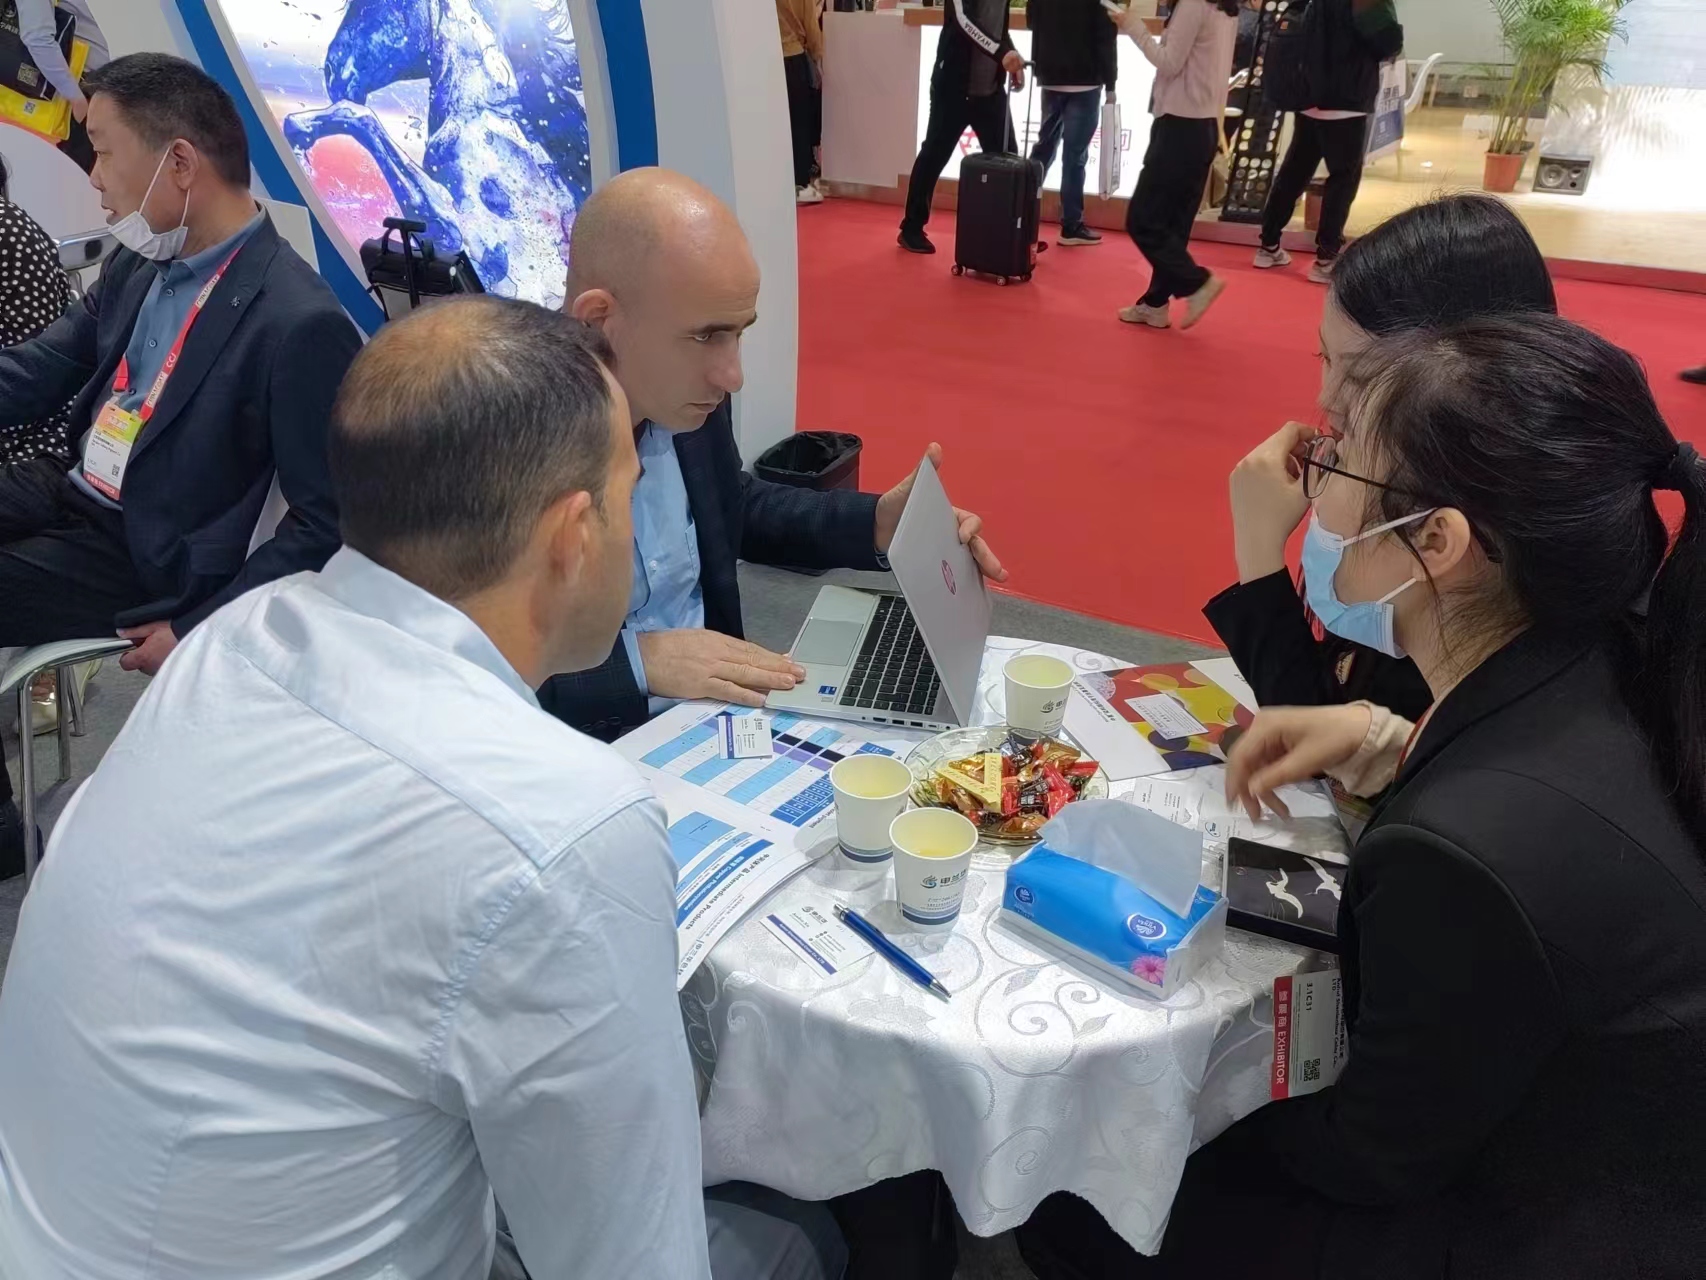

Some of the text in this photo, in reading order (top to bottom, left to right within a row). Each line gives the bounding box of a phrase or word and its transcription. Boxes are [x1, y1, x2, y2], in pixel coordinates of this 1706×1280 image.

[709, 871, 743, 905] Intermediate
[684, 902, 710, 931] Products
[1276, 1031, 1286, 1084] EXHIBITOR
